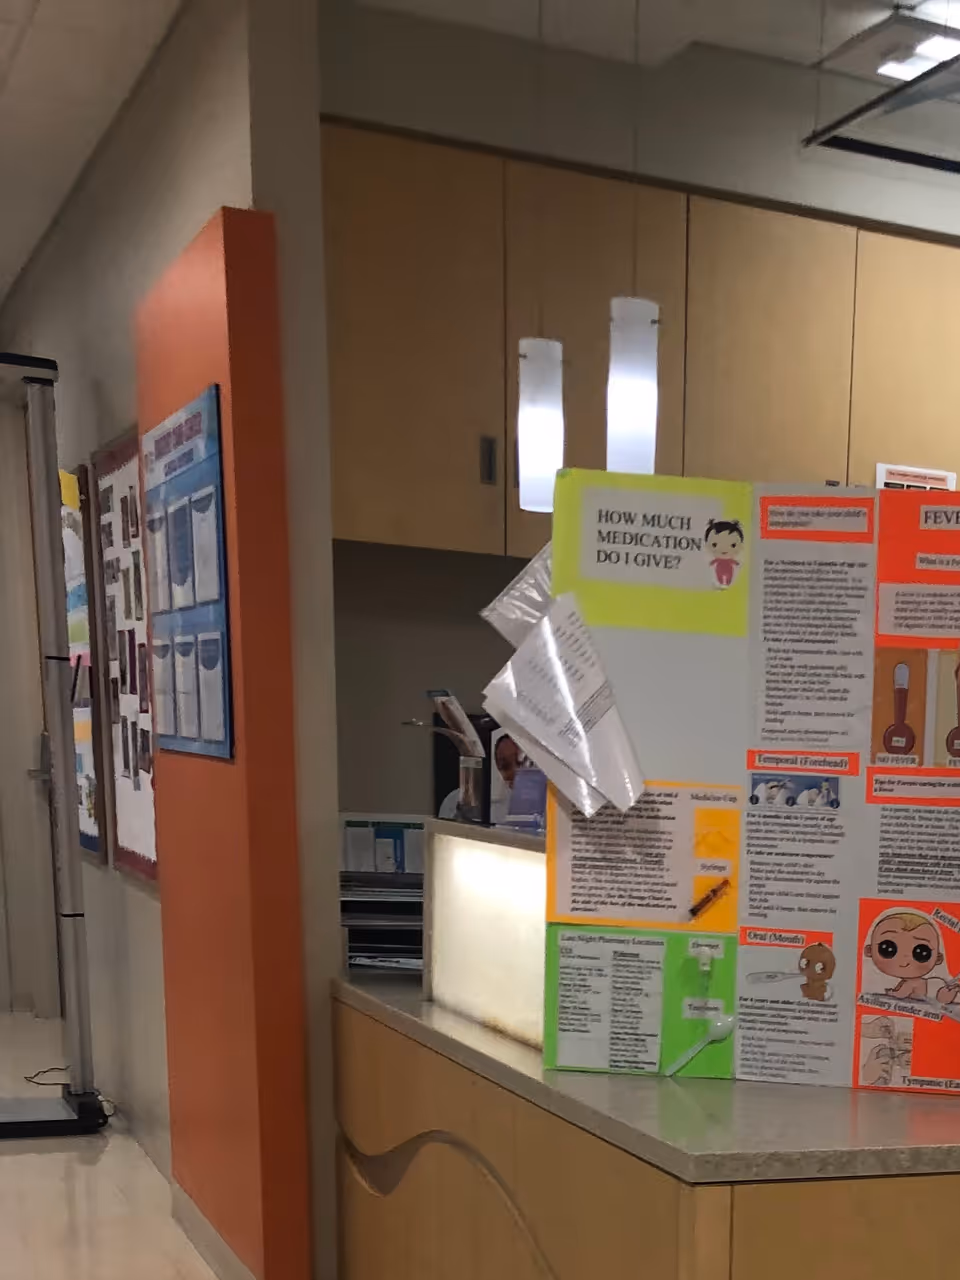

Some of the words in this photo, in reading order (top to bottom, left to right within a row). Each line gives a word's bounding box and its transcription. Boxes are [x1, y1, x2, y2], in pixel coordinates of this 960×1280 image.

[597, 509, 637, 526] HOW
[641, 513, 692, 531] MUCH
[597, 529, 702, 551] MEDICATION
[596, 550, 620, 564] DO
[624, 552, 630, 565] I
[634, 552, 682, 570] GIVE?
[919, 556, 937, 565] What
[891, 757, 917, 765] FEVER
[747, 931, 767, 941] Oral
[893, 1003, 922, 1016] (under
